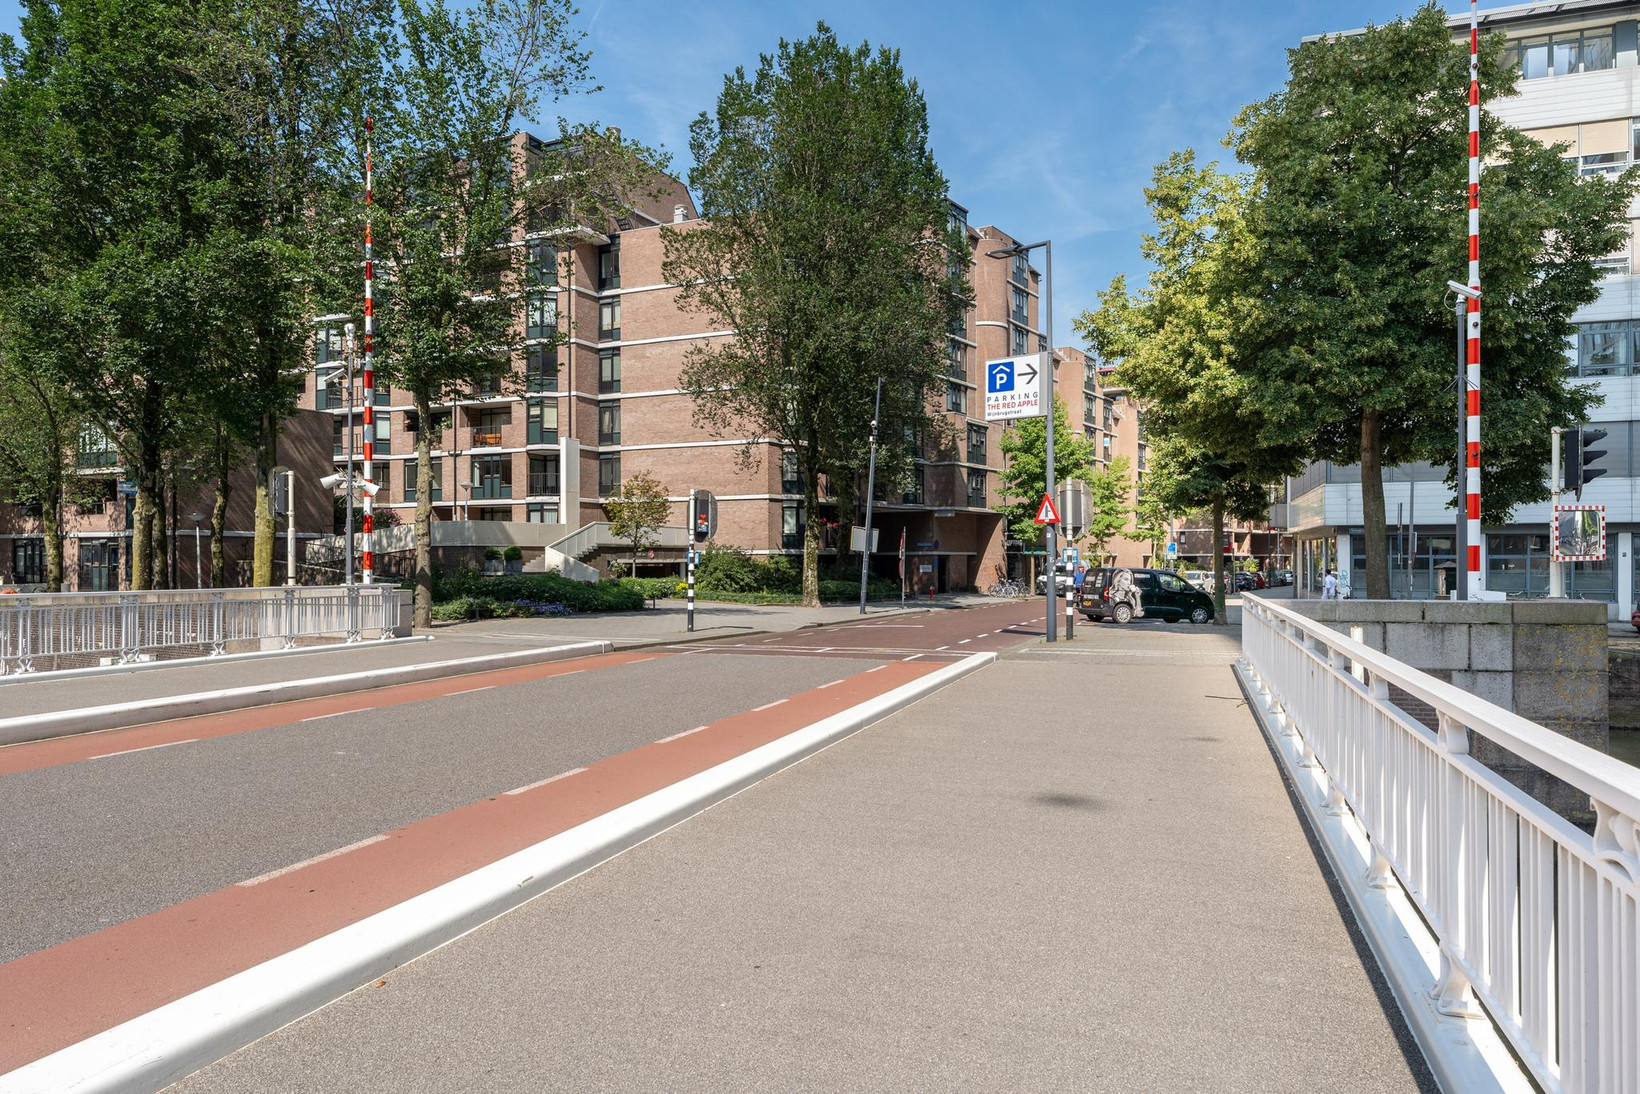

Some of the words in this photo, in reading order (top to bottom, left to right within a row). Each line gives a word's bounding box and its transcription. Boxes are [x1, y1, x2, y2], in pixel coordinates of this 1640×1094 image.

[996, 373, 1008, 389] P
[987, 391, 1038, 403] PARKING
[1017, 399, 1038, 407] APPLE
